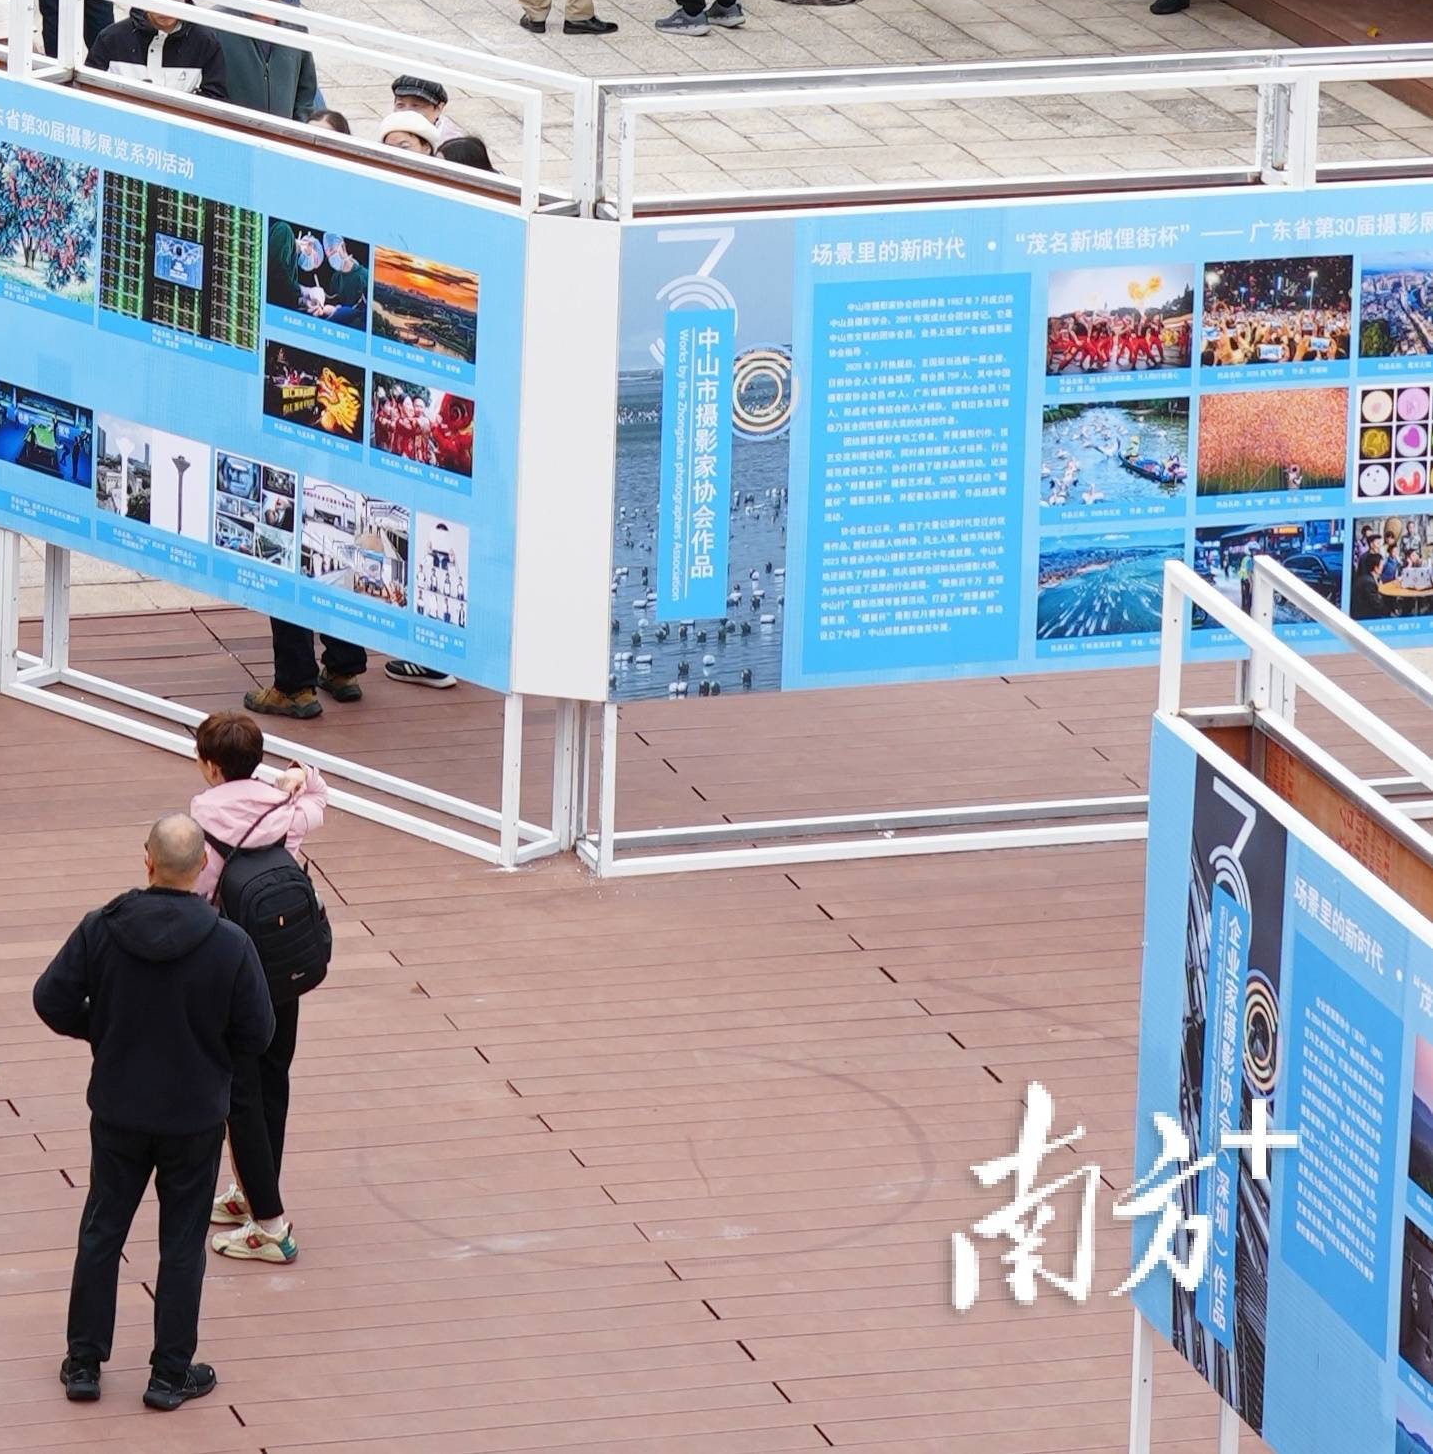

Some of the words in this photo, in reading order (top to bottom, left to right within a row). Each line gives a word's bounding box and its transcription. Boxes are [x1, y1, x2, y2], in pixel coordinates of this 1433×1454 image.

[811, 234, 966, 265] 场景里的新时代
[1015, 223, 1191, 256] “茂名新城俚街杯”
[677, 365, 688, 378] by
[678, 328, 689, 363] Works
[678, 381, 688, 398] the
[675, 401, 687, 460] Zhongshan
[690, 327, 720, 580] 中山市摄影家协会作品
[673, 462, 685, 539] photographers
[672, 541, 683, 601] Association
[1294, 875, 1385, 975] 场景里的新时代
